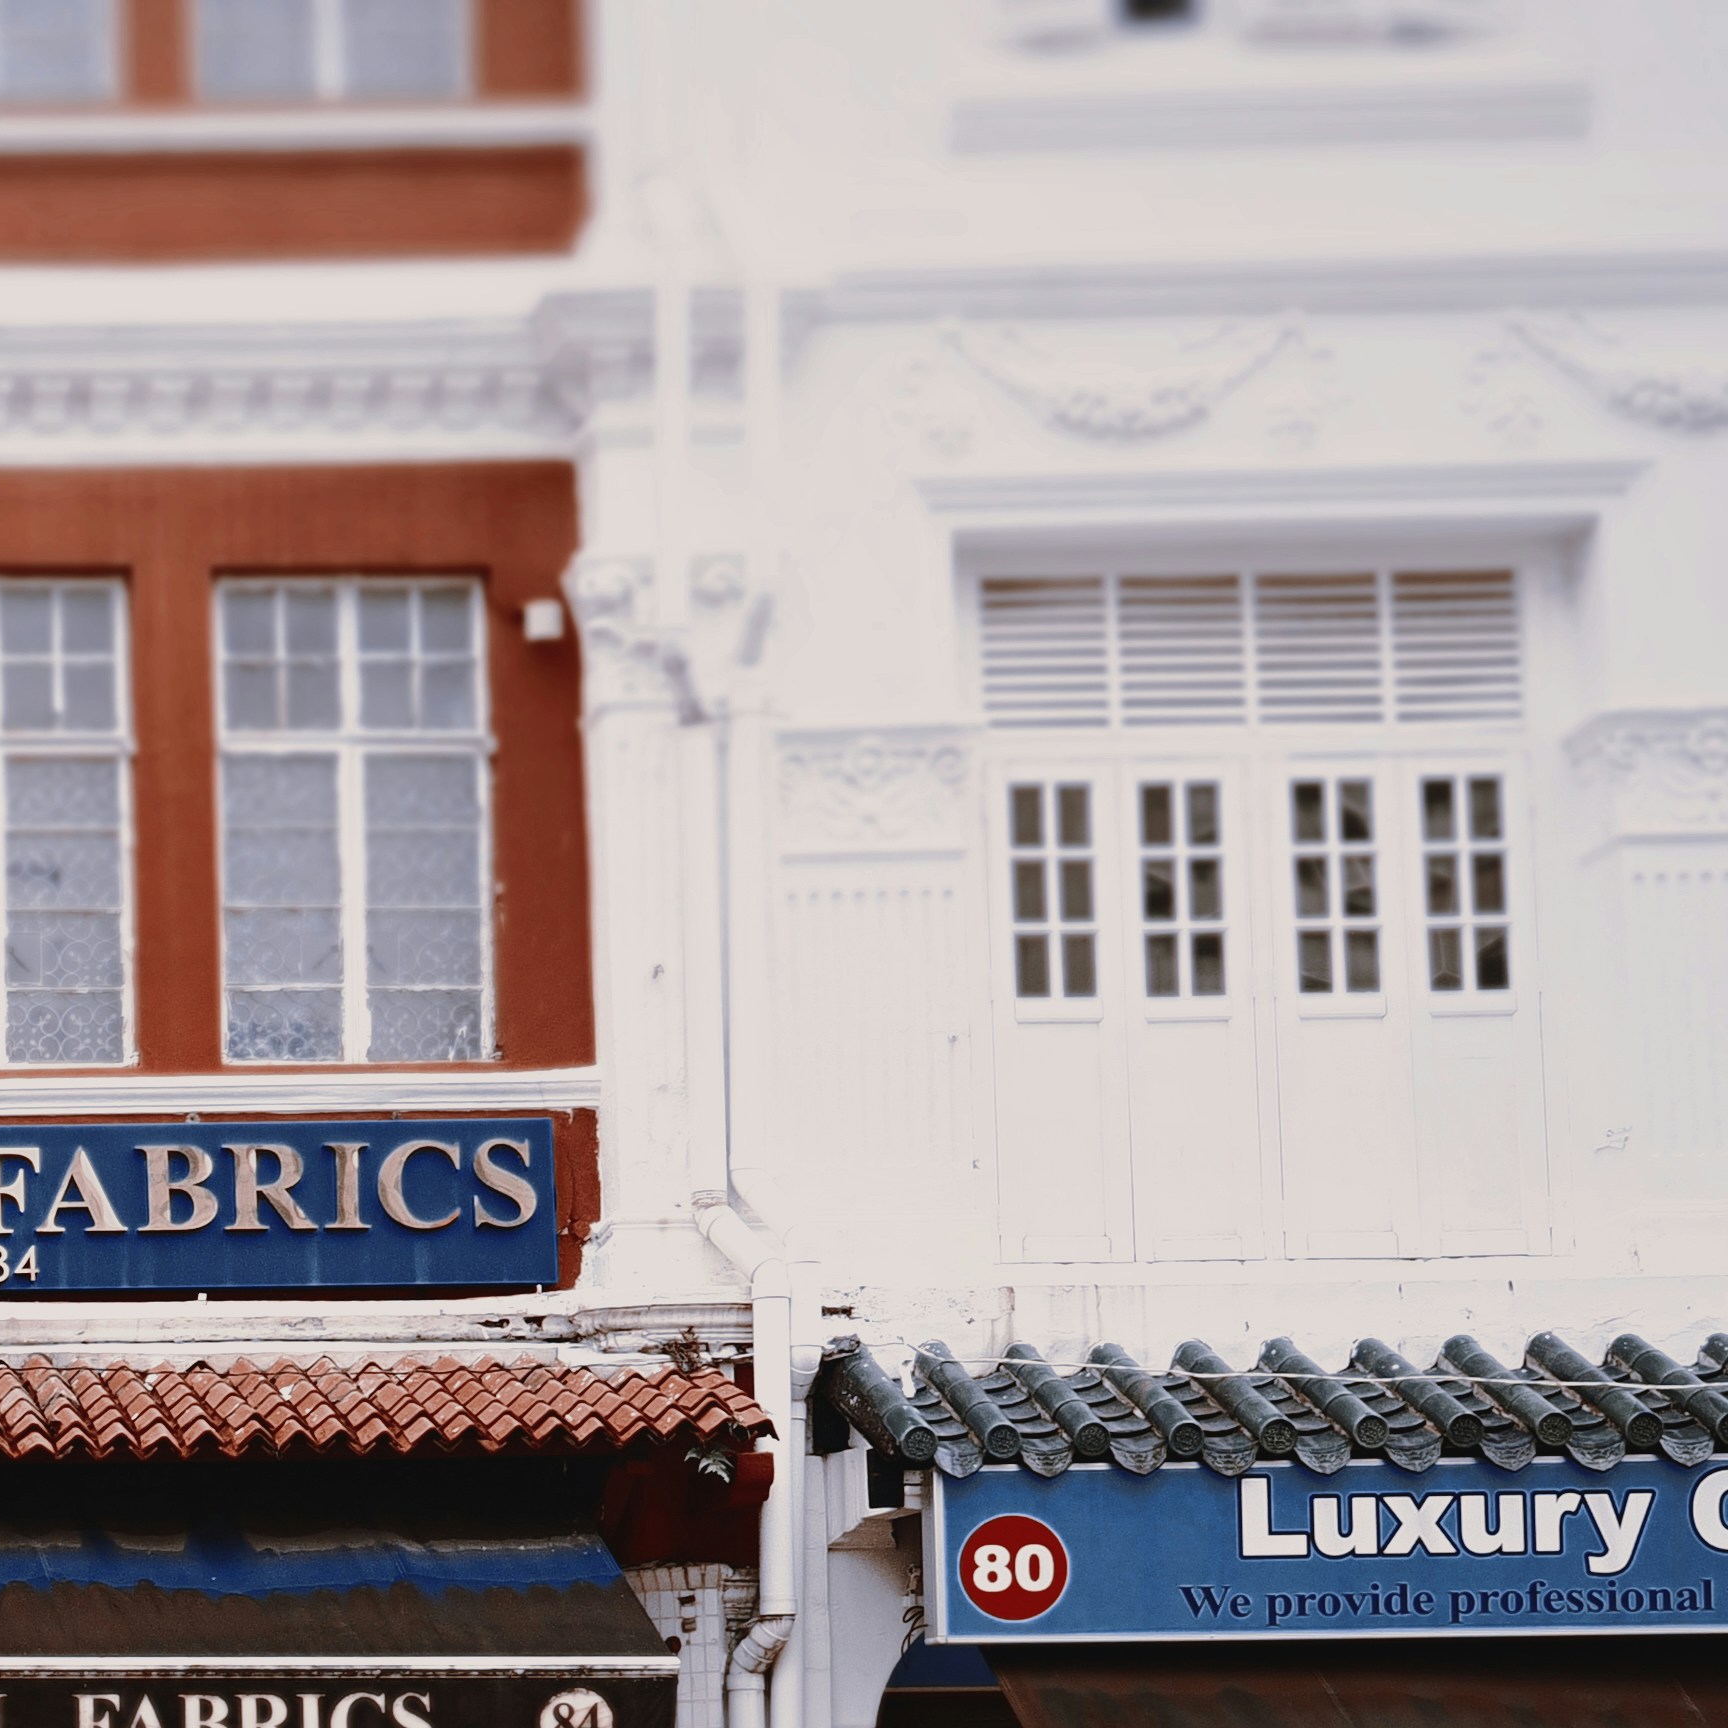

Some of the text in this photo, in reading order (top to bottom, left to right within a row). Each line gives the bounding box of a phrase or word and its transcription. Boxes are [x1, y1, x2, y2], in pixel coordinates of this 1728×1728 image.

[1238, 1476, 1654, 1575] Luxury
[973, 1543, 1056, 1593] 80
[1178, 1579, 1715, 1627] We provide professional
